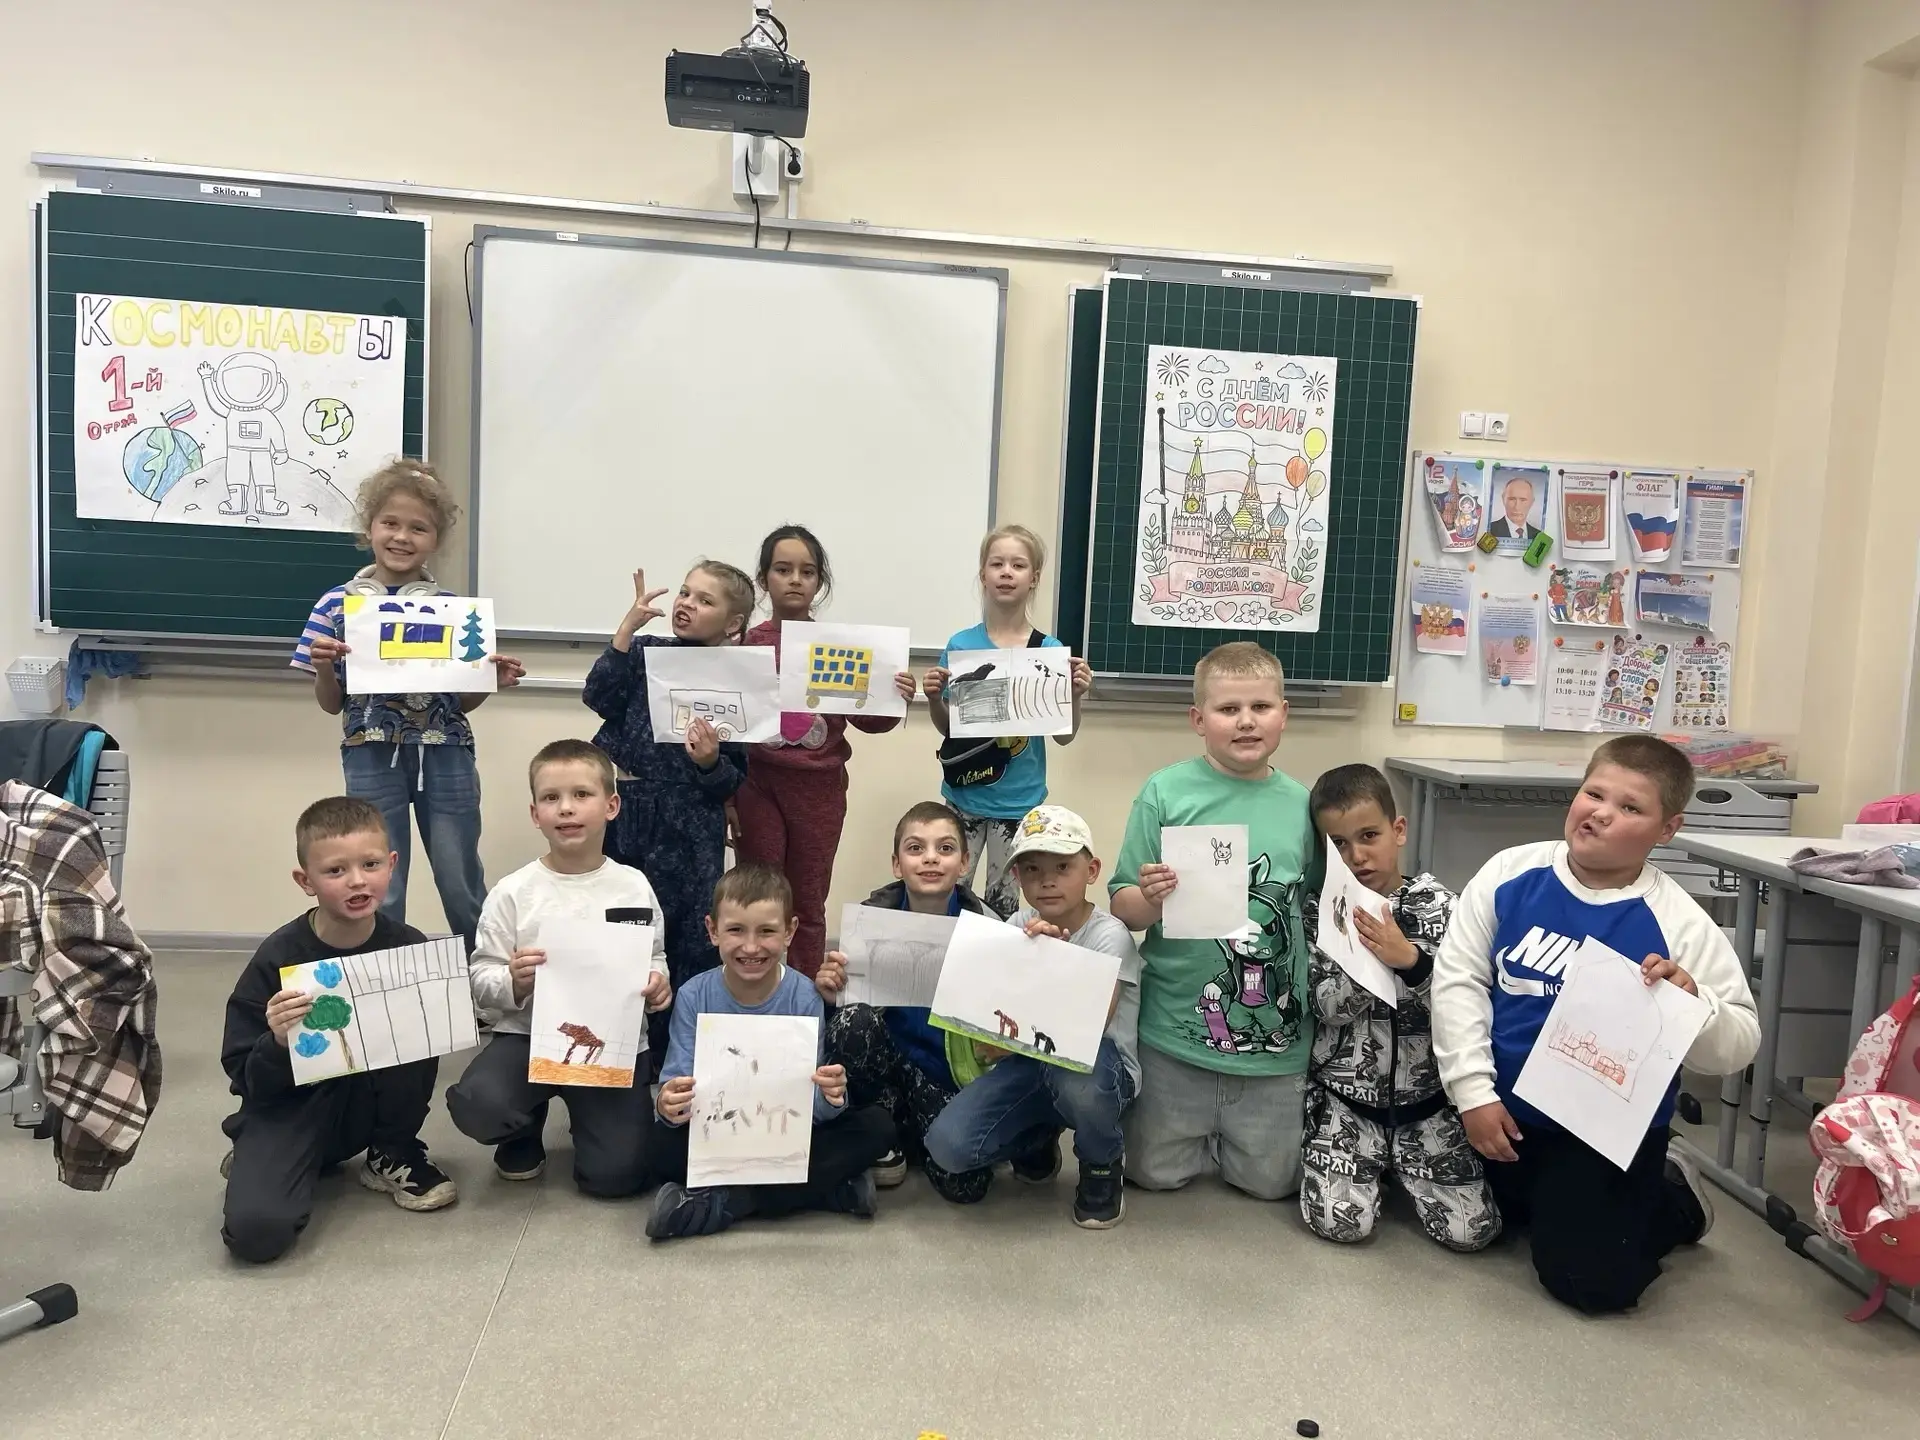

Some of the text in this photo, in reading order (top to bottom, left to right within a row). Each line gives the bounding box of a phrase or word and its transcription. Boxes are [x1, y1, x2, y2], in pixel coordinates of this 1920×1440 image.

[213, 186, 249, 197] Skilo.ru
[81, 296, 393, 361] КОСМОНАВТЫ
[1196, 376, 1290, 403] С ДНЁМ
[1178, 400, 1307, 435] РОССИИ!
[1428, 465, 1445, 479] 12
[1636, 483, 1663, 492] ФЛАГ
[1196, 566, 1250, 579] РОССИЯ
[1186, 579, 1275, 594] РОДИНА МОЯ!
[1622, 655, 1651, 672] Добрые
[957, 766, 993, 785] Victory
